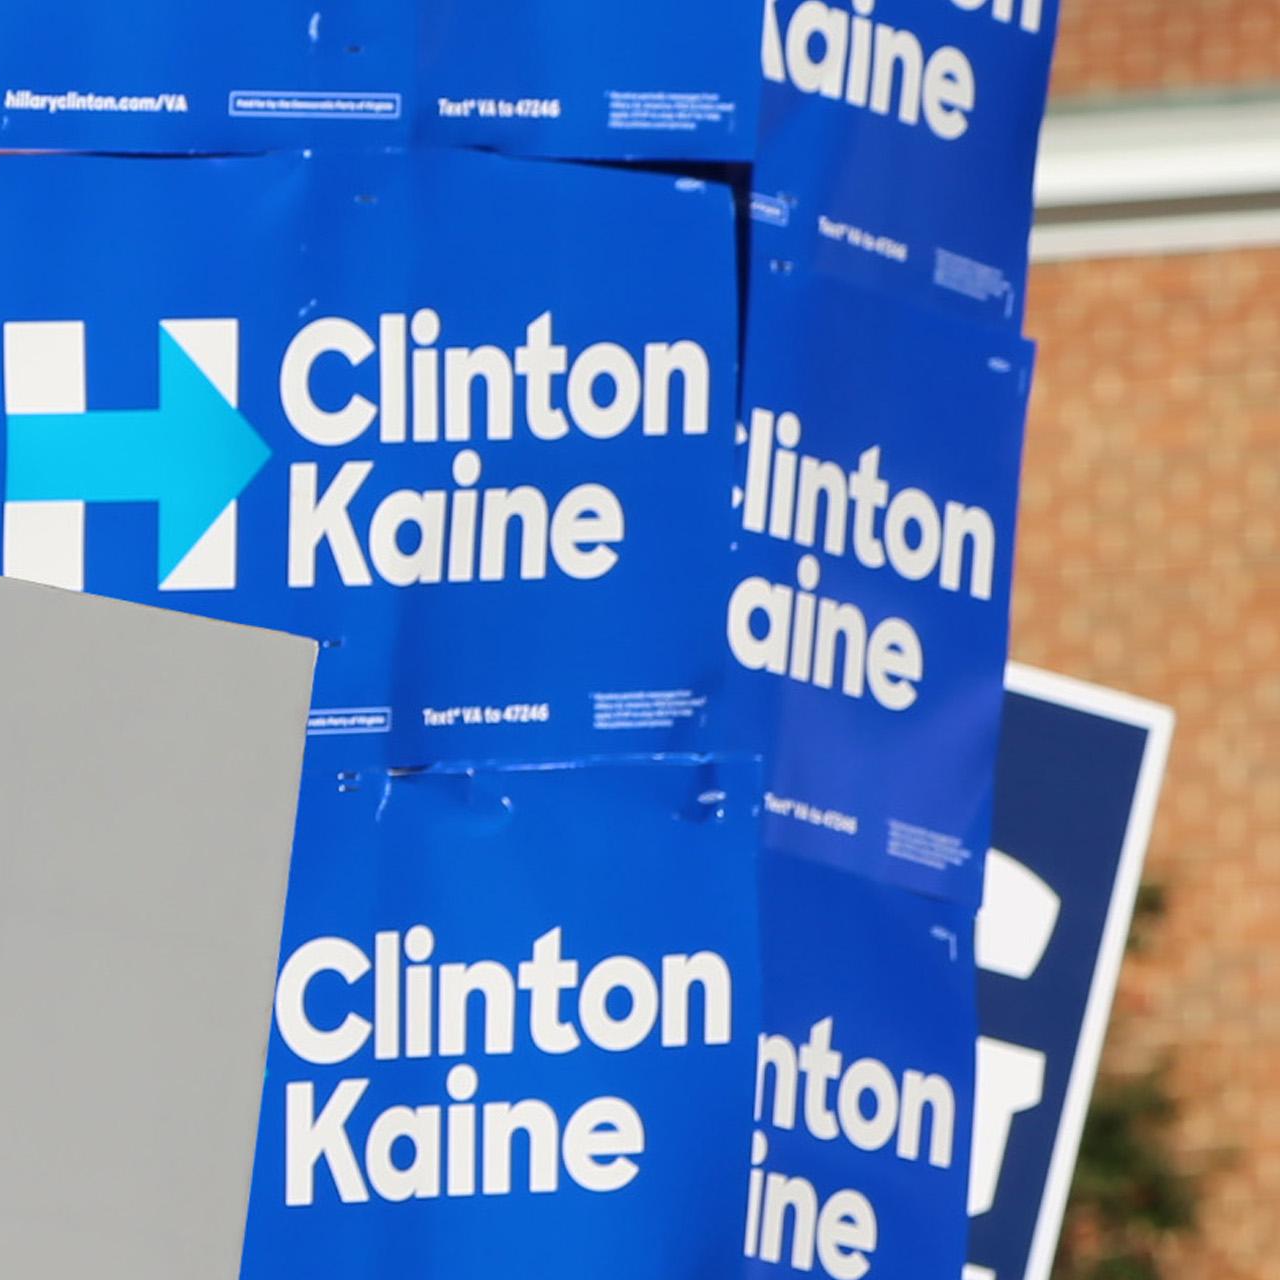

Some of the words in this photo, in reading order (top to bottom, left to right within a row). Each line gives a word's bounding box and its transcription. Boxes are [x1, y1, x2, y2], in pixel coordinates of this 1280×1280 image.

[4, 90, 188, 114] hillaryclinton.com/VA
[280, 308, 710, 446] Clinton
[288, 449, 625, 588] Kaine
[732, 407, 995, 601] linton
[275, 924, 732, 1065] Clinton
[285, 1064, 645, 1207] Kaine
